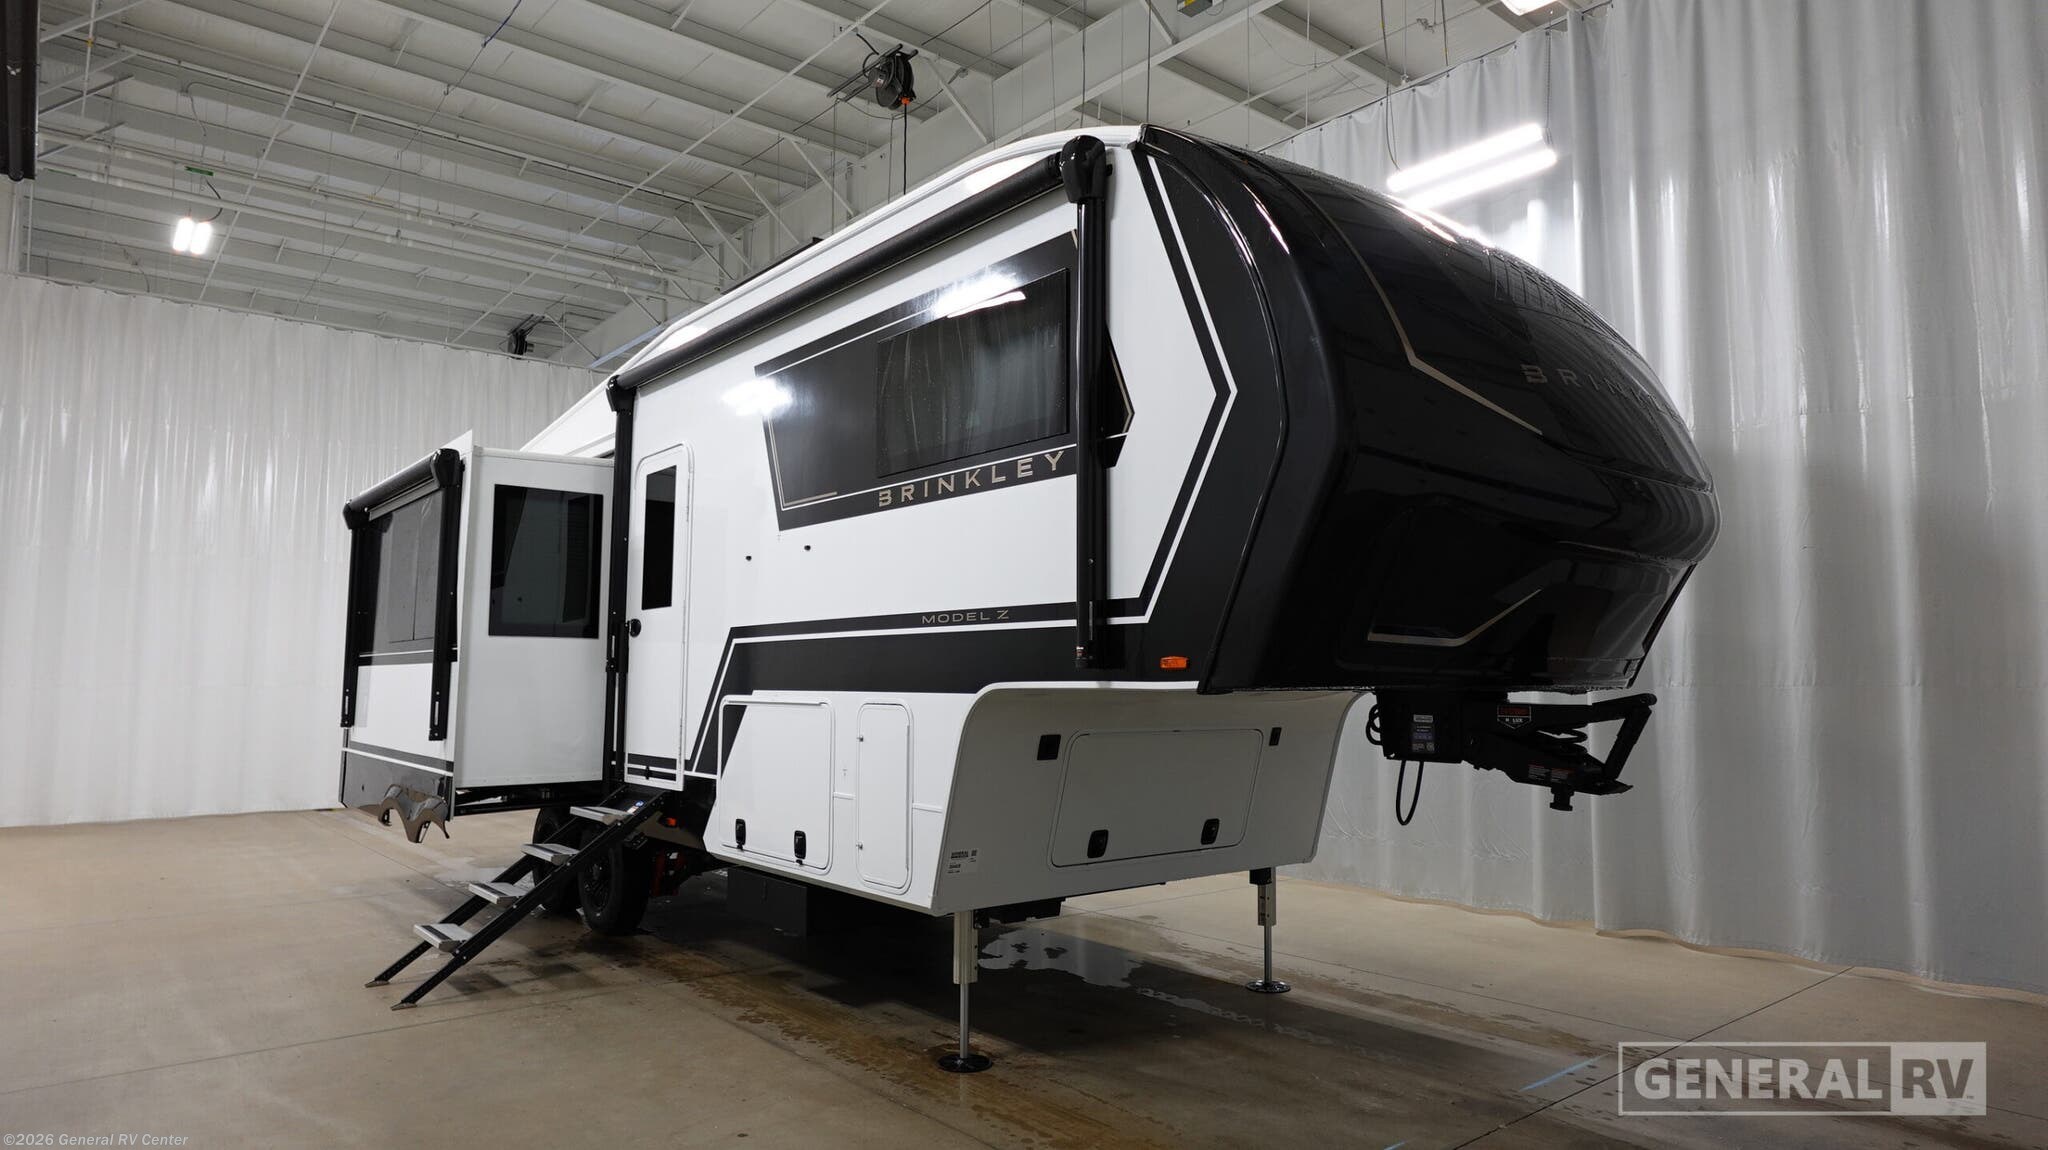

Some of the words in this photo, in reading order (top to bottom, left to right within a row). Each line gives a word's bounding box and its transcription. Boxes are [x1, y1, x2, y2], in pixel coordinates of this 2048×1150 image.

[1520, 364, 1683, 424] BRINKL
[878, 450, 1064, 507] BRINKLEY
[921, 612, 990, 624] MODEL
[997, 609, 1009, 620] Z
